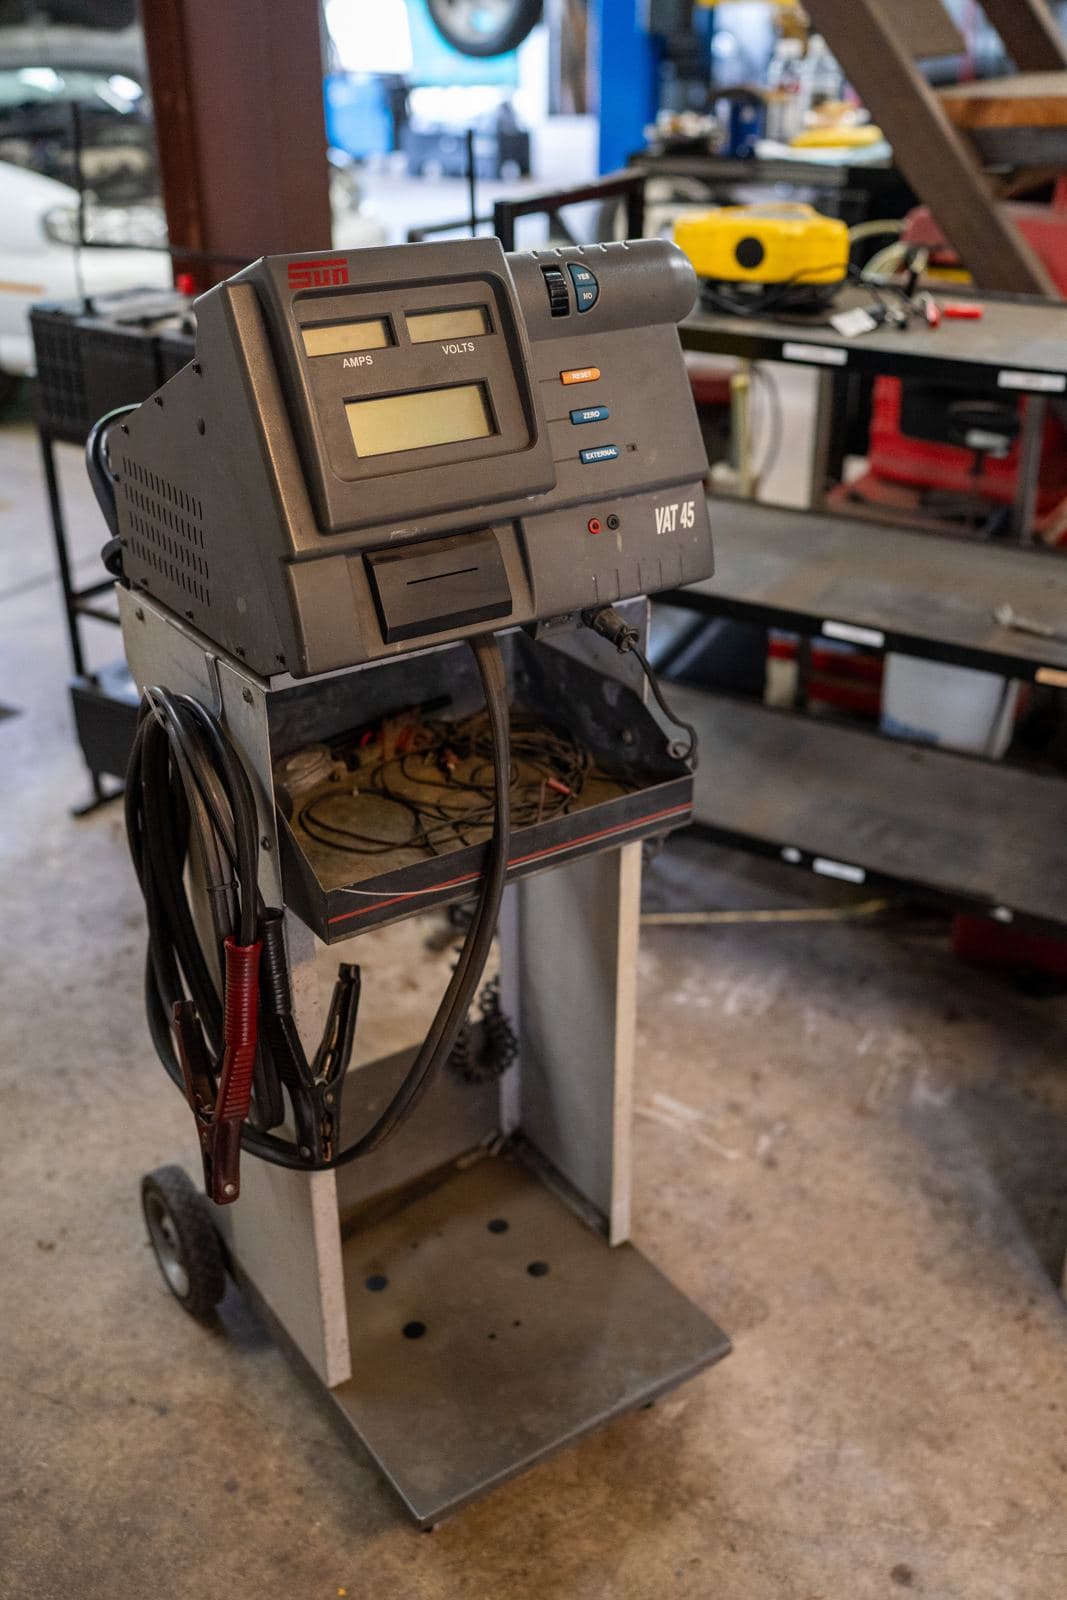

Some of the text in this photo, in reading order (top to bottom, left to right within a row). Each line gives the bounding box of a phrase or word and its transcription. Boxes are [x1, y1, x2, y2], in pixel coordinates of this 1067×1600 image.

[583, 292, 593, 300] NO
[441, 342, 475, 355] VOLTS
[342, 355, 374, 368] AMPS
[582, 410, 600, 420] ZERO
[585, 448, 617, 460] EXTERNAL
[655, 501, 695, 535] VAT 45
